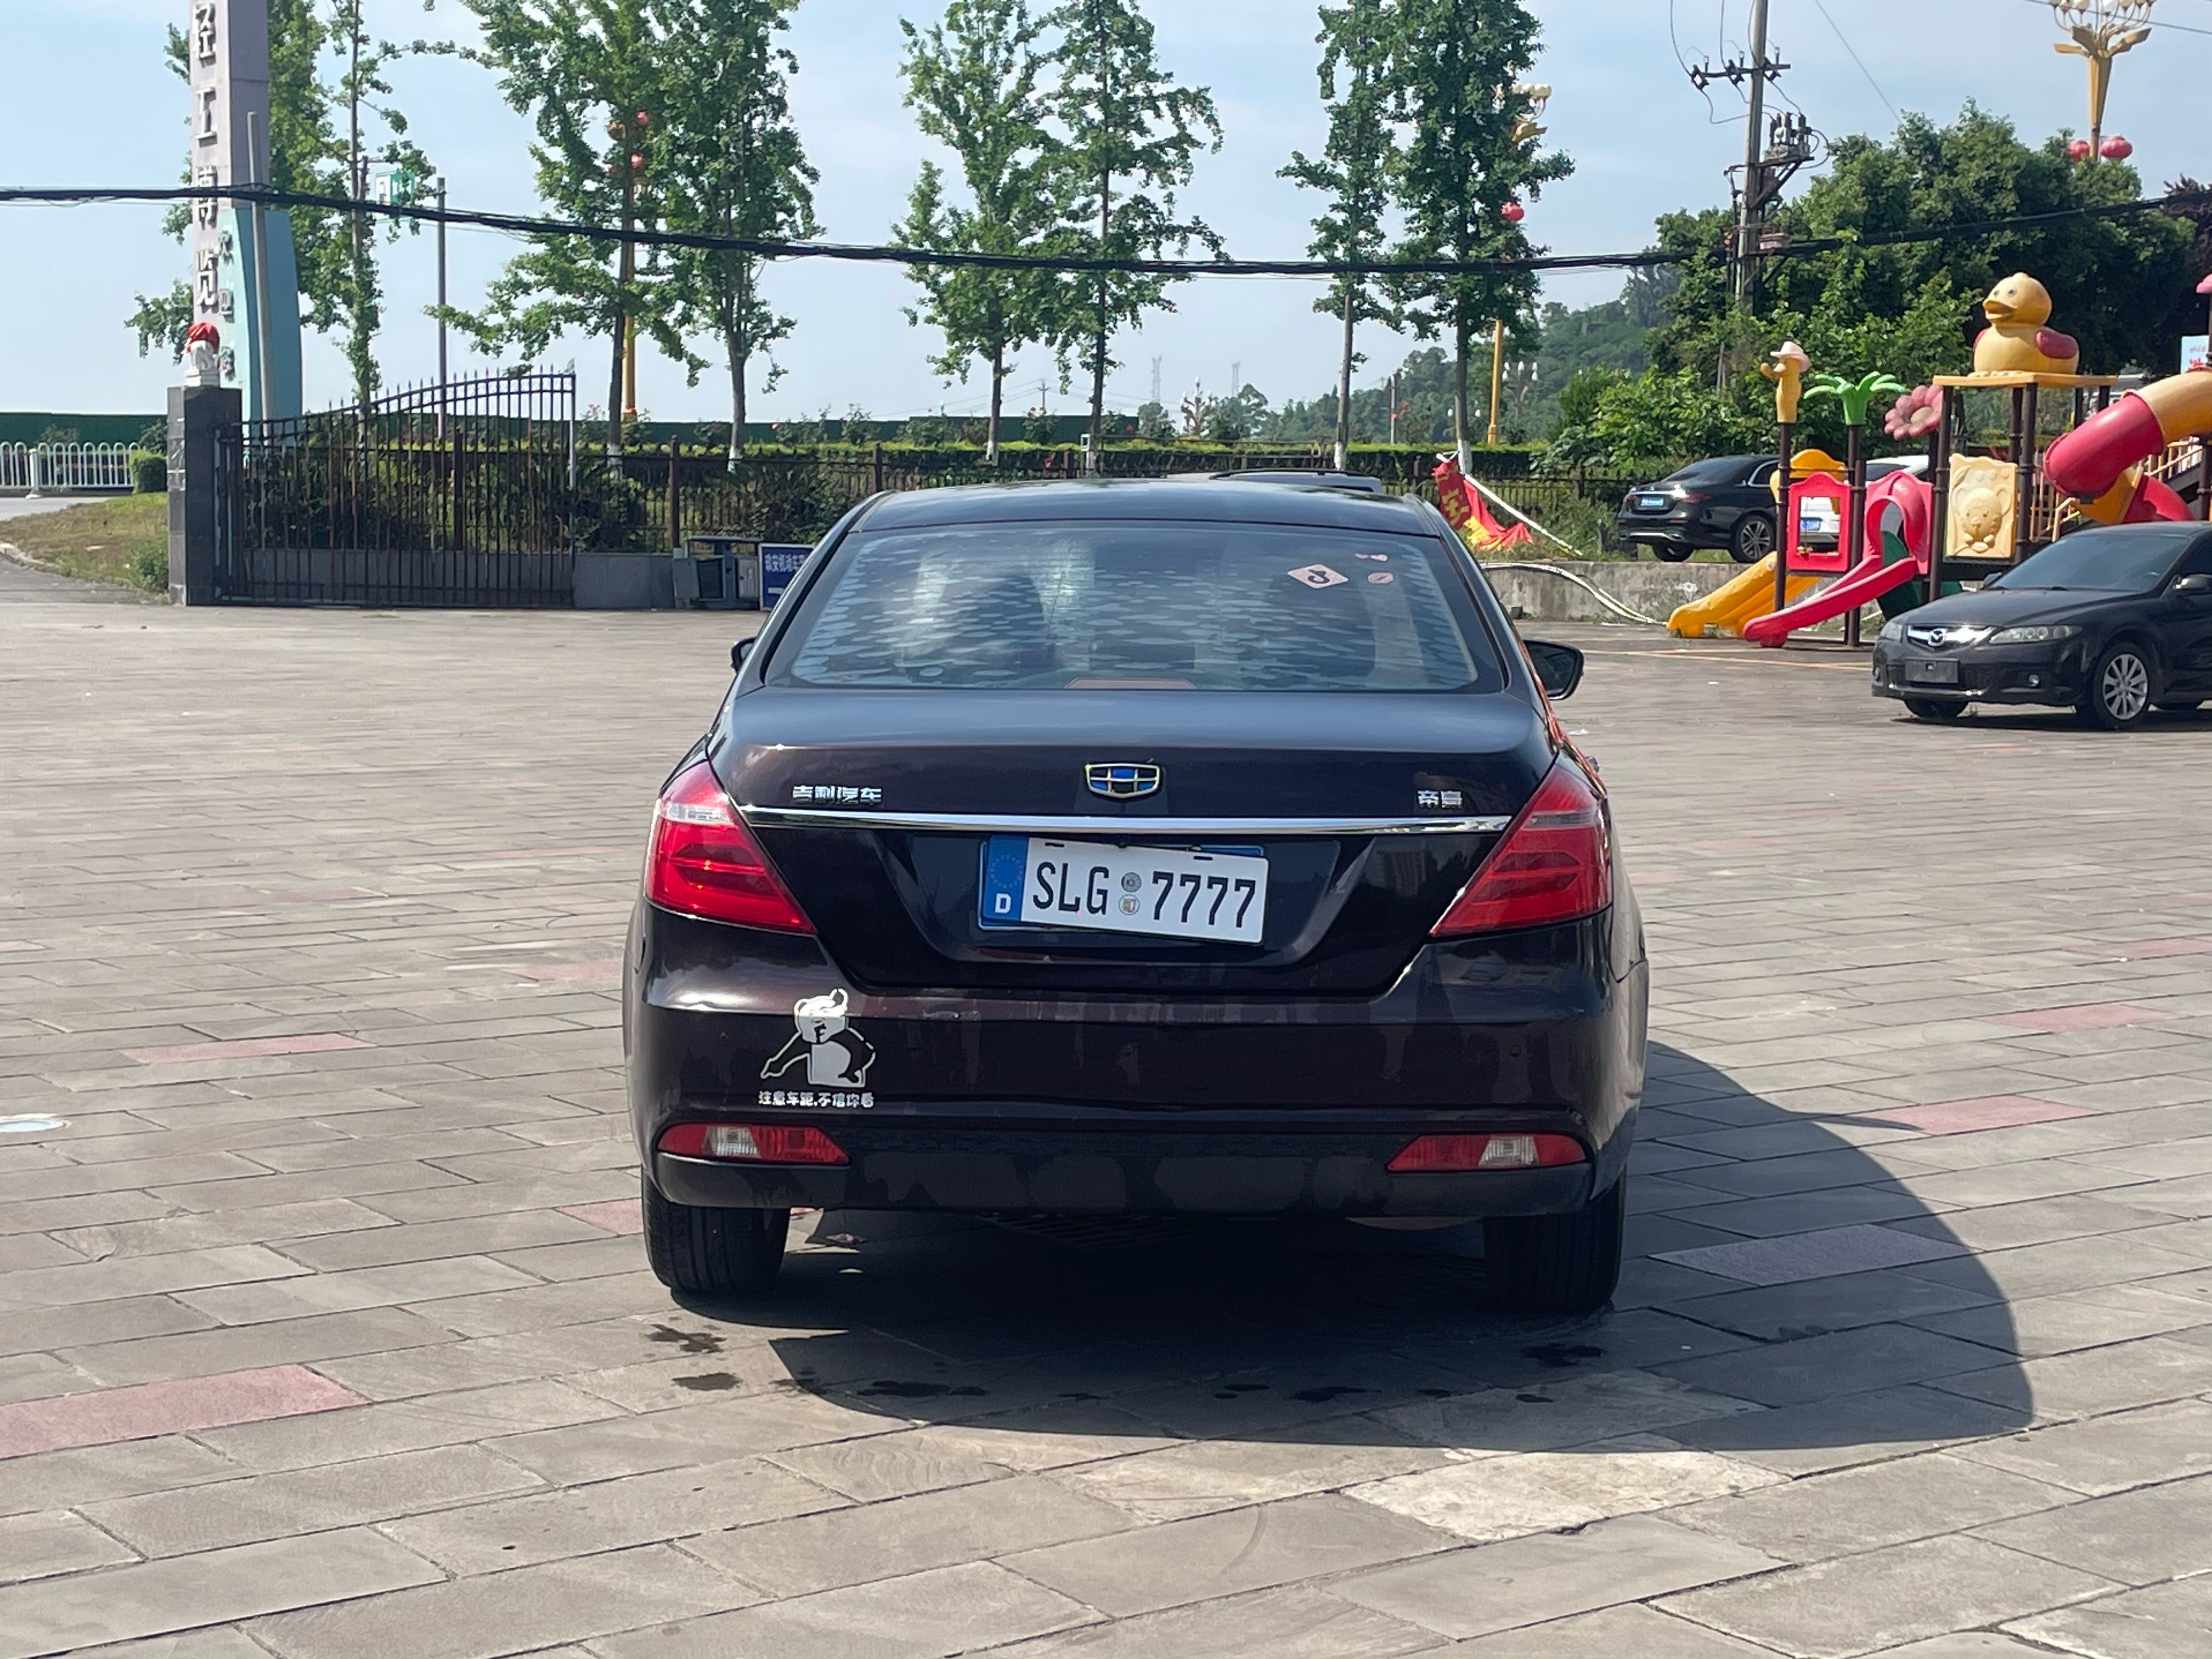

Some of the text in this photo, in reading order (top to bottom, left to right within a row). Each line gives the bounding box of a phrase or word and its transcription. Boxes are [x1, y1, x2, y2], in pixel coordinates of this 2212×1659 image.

[793, 785, 882, 805] 吉利汽车
[994, 893, 1012, 914] D
[1032, 861, 1256, 928] SLG 7777
